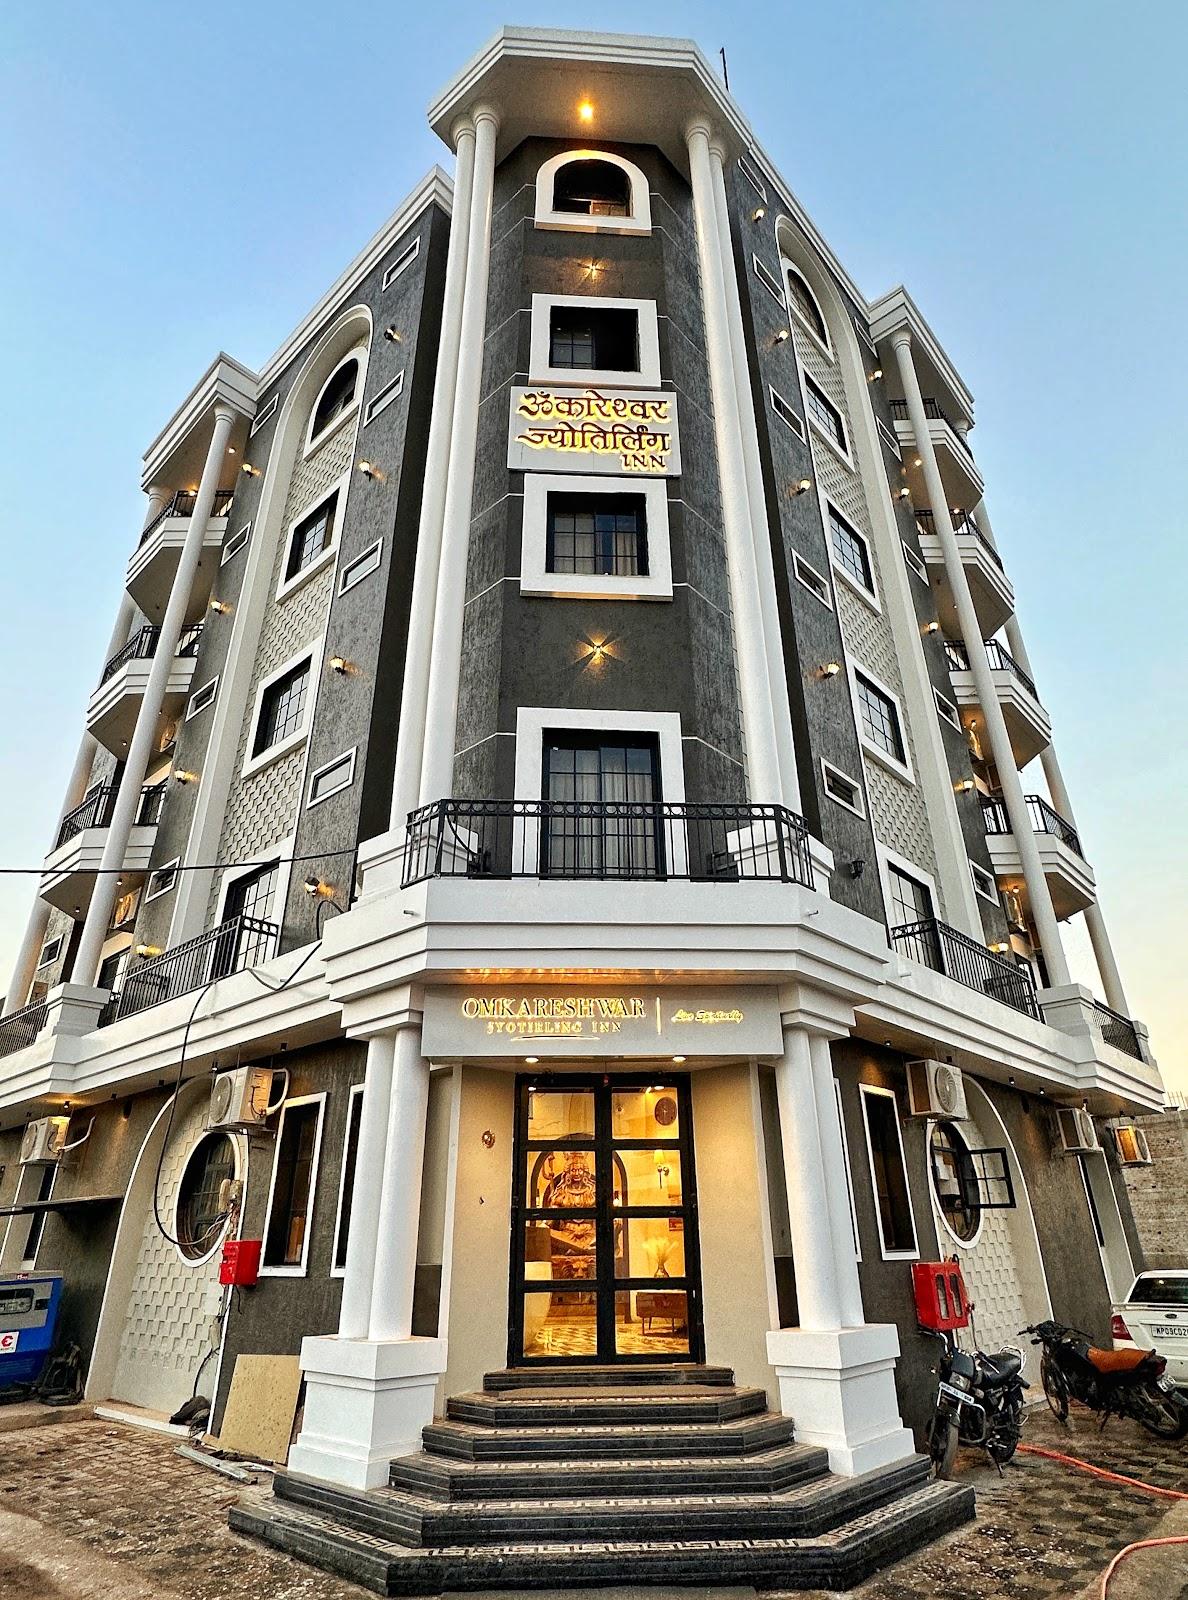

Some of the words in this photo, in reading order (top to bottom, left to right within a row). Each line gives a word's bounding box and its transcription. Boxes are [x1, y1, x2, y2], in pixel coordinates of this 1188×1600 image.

[622, 454, 666, 468] INN
[461, 997, 647, 1019] OMKARESHWAR
[487, 1021, 583, 1034] JYOTIRLING
[591, 1021, 621, 1033] INN
